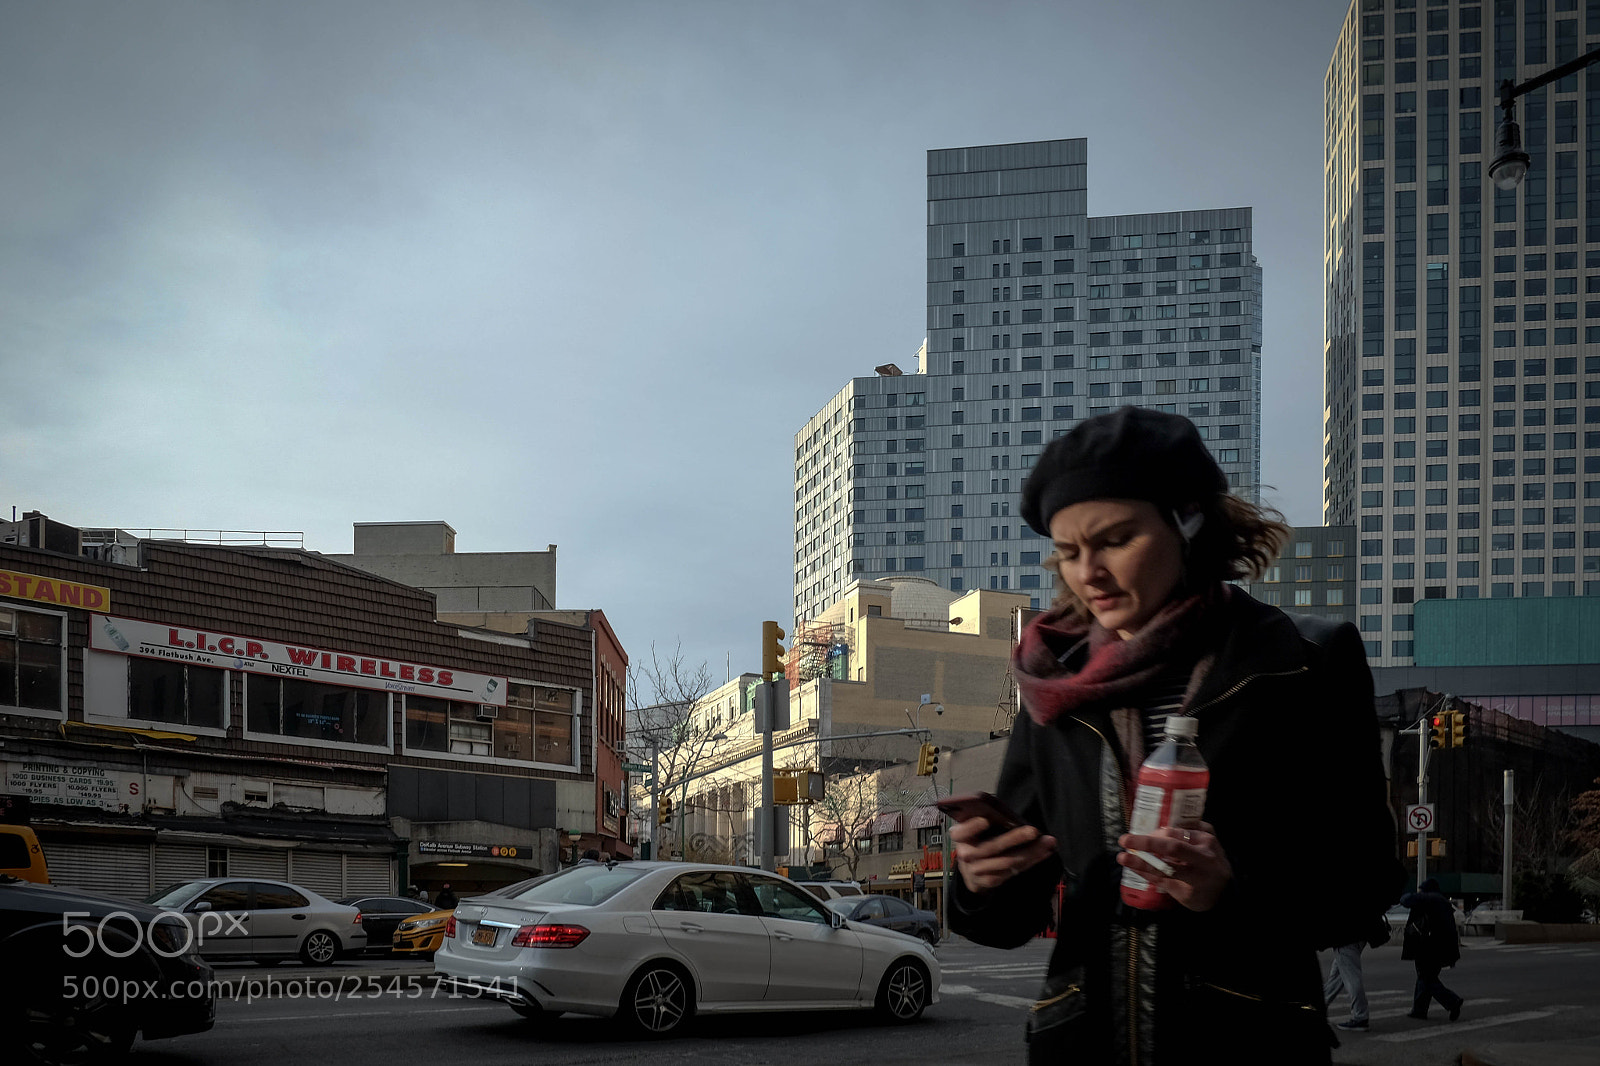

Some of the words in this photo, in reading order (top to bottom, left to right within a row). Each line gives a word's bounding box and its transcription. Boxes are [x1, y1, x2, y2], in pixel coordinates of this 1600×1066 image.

[0, 573, 103, 608] STAND
[139, 646, 155, 655] 394
[158, 649, 193, 660] Flatbush
[196, 654, 214, 664] Ave.
[168, 628, 269, 659] L.I.C.P.
[285, 647, 454, 686] WIRELESS
[271, 664, 308, 677] NEXTEL
[22, 762, 59, 773] PRINTING
[63, 765, 68, 774] &
[72, 766, 105, 777] COPYING
[31, 774, 66, 783] BUSINESS
[69, 777, 92, 785] CARDS
[129, 782, 139, 795] S
[28, 795, 51, 803] OPIES
[54, 796, 64, 804] AS
[66, 797, 83, 805] LOW
